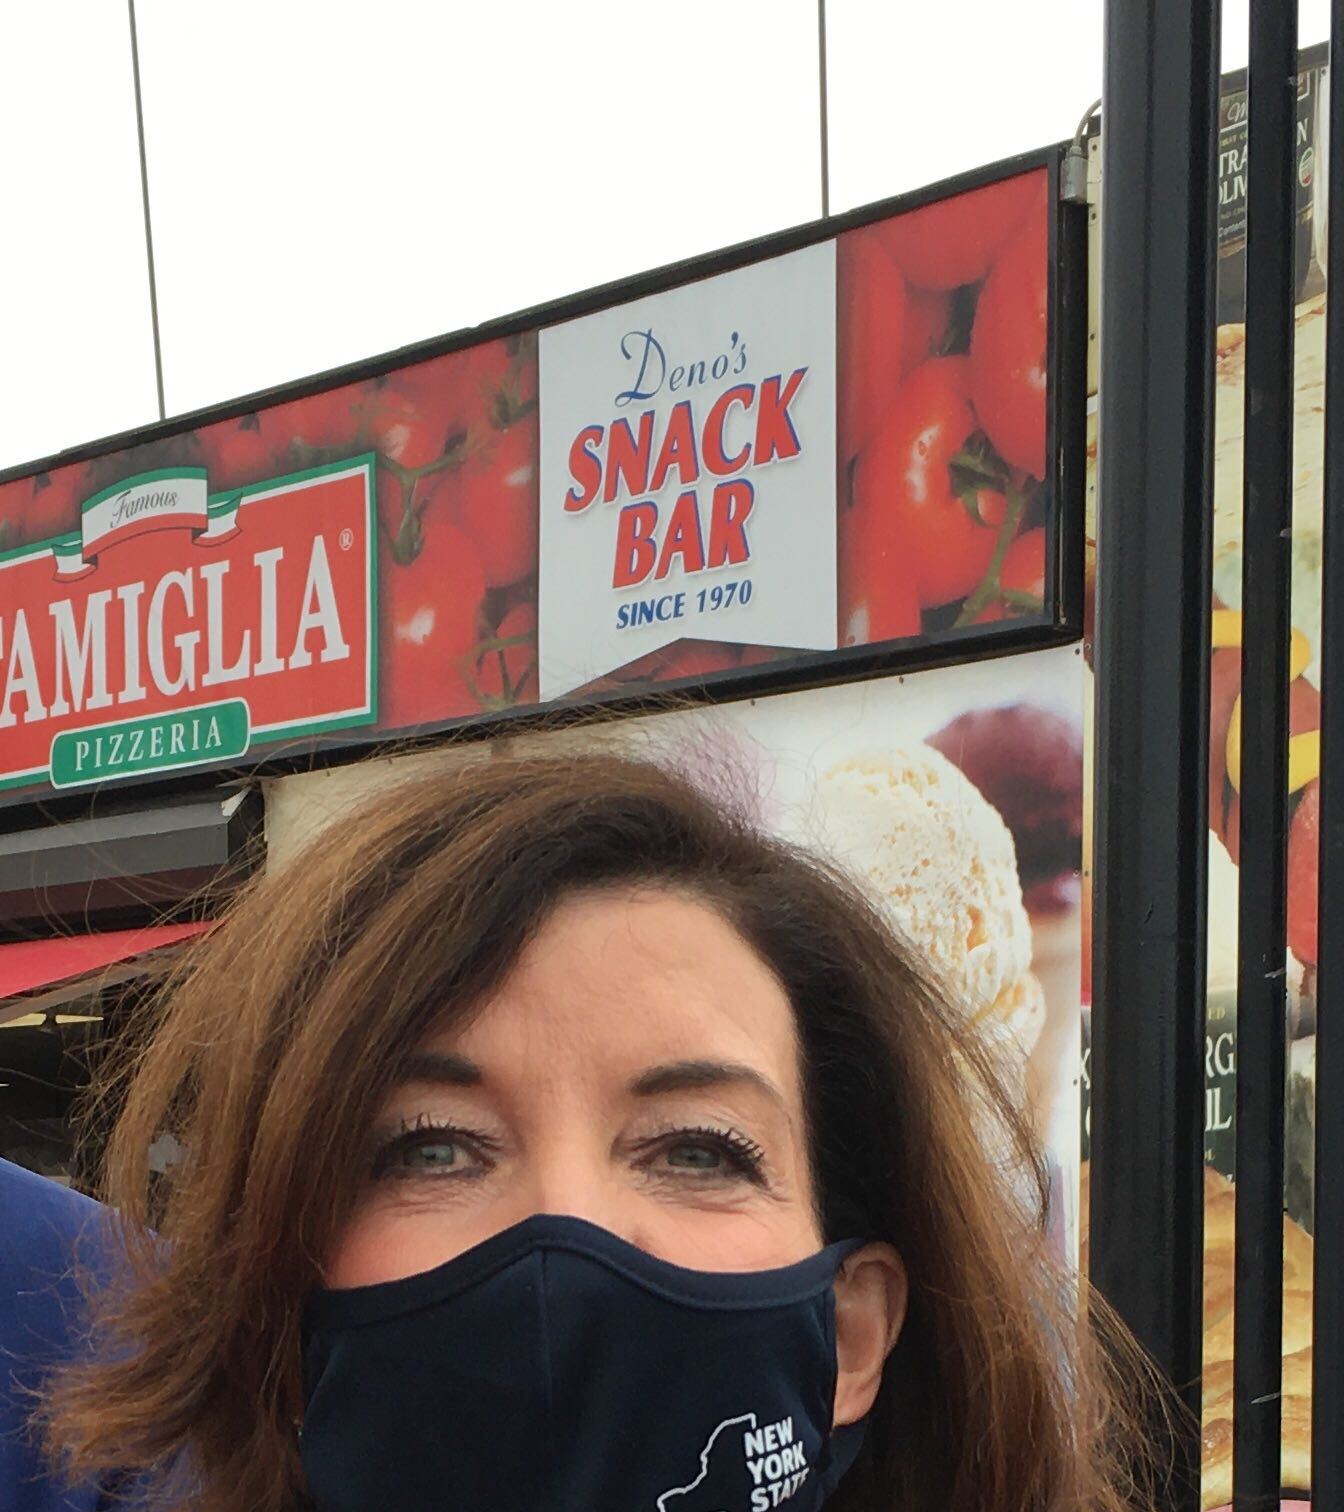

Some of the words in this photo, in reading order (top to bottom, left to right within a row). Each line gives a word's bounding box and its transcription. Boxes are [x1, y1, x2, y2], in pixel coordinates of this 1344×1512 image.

[613, 326, 749, 408] Deno's
[562, 366, 809, 513] SNACK
[110, 488, 180, 528] Famous
[611, 478, 755, 589] BAR
[615, 594, 685, 631] SINCE
[695, 579, 753, 615] 1970
[74, 711, 224, 773] PIZZERIA
[744, 1415, 793, 1458] NEW
[746, 1440, 807, 1485] YORK
